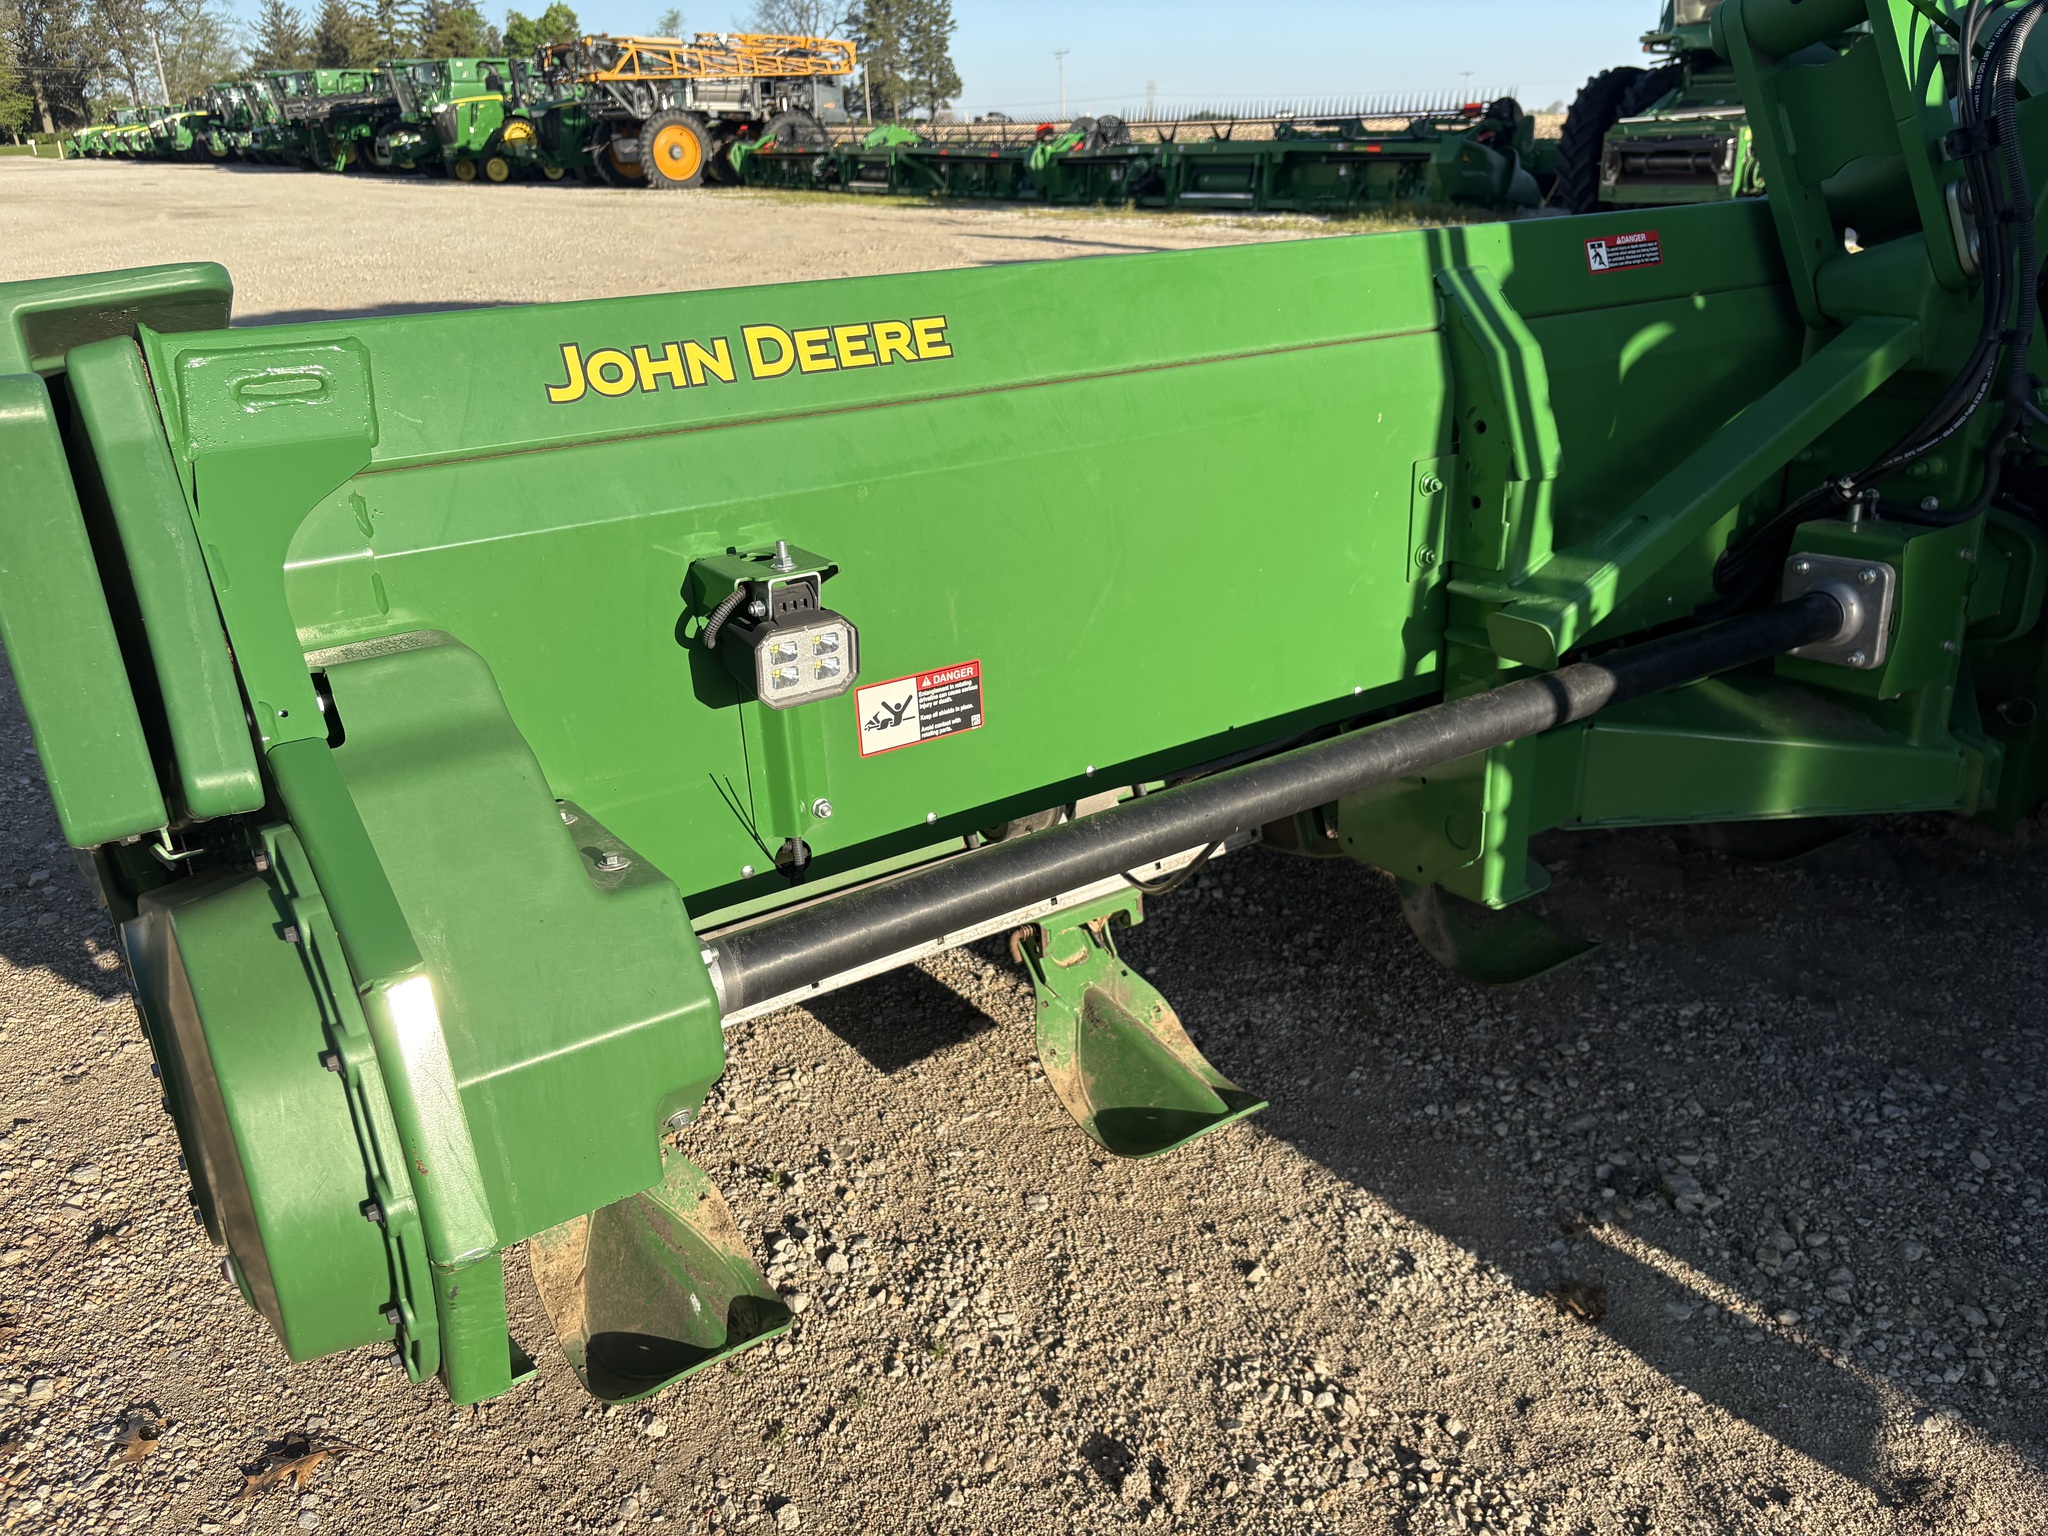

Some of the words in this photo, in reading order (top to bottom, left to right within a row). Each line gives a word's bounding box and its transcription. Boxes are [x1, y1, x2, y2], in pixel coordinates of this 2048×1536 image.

[1987, 41, 1995, 50] EN
[1978, 62, 1987, 74] 1SC
[1976, 74, 1982, 84] DN
[1621, 234, 1646, 243] DANGER
[544, 336, 739, 404] JOHN
[740, 316, 954, 379] DEERE
[933, 667, 973, 684] DANGER
[919, 685, 949, 697] Entanglement
[919, 694, 938, 703] driveline
[939, 708, 954, 716] shields
[935, 720, 951, 728] contact
[922, 730, 938, 738] rotating
